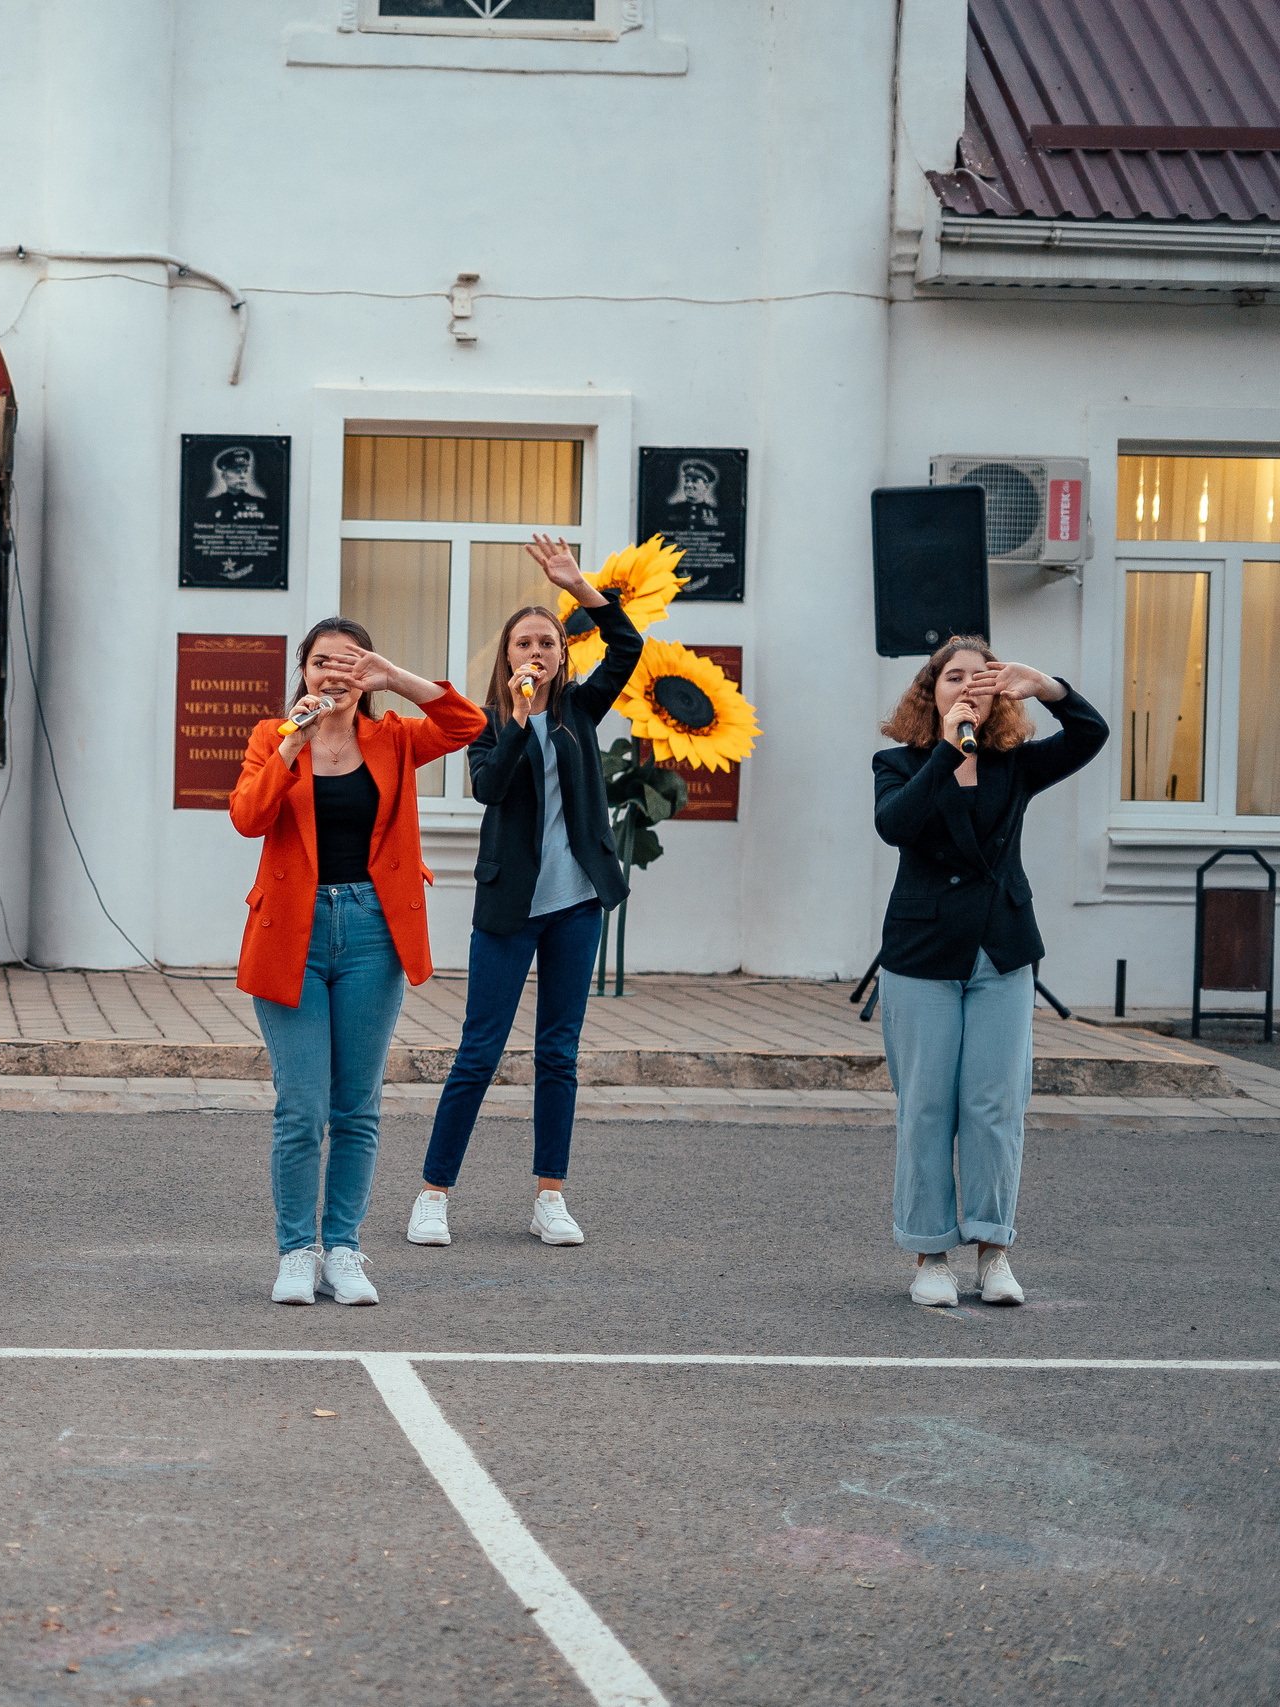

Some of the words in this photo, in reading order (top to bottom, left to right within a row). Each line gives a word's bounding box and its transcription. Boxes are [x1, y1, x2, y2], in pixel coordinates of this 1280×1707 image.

[1060, 493, 1071, 540] CENTEK
[190, 679, 269, 692] ПОМНИТЕ!
[184, 702, 230, 715] ЧЕРЕЗ
[180, 724, 226, 737] ЧЕРЕЗ
